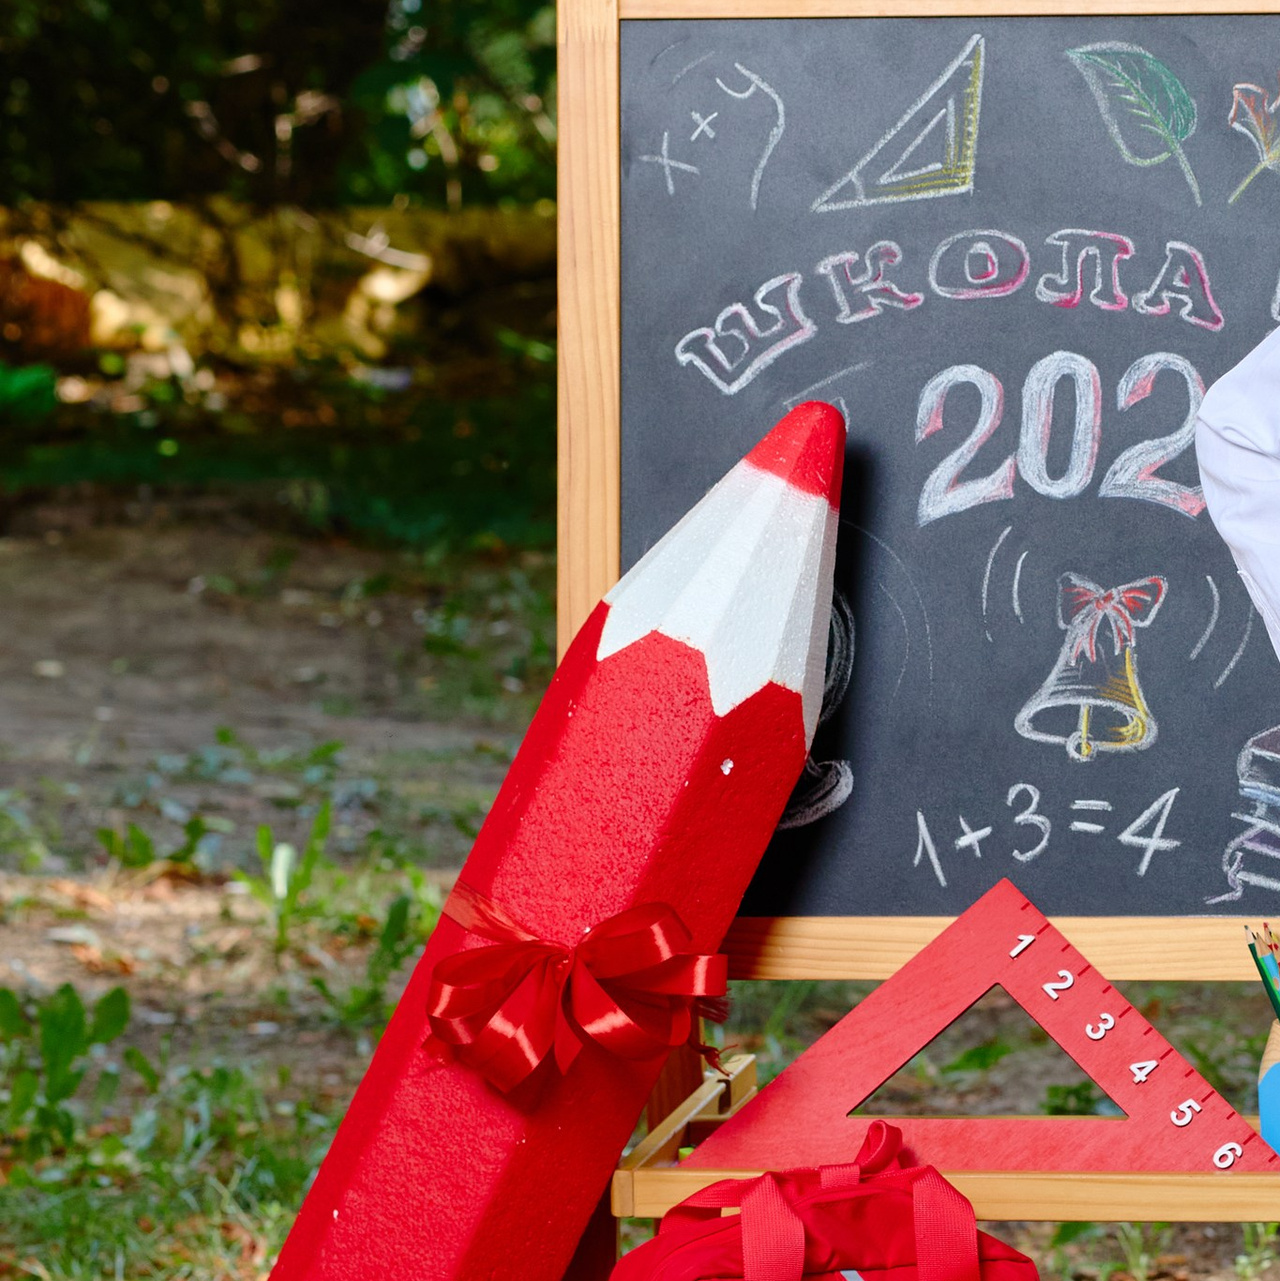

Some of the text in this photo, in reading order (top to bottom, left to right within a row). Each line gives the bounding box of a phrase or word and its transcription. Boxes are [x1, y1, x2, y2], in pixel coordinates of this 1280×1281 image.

[674, 228, 1226, 395] ШКОЛА
[914, 349, 1207, 527] 202
[1009, 934, 1244, 1170] 1 2 3 4 5 6
